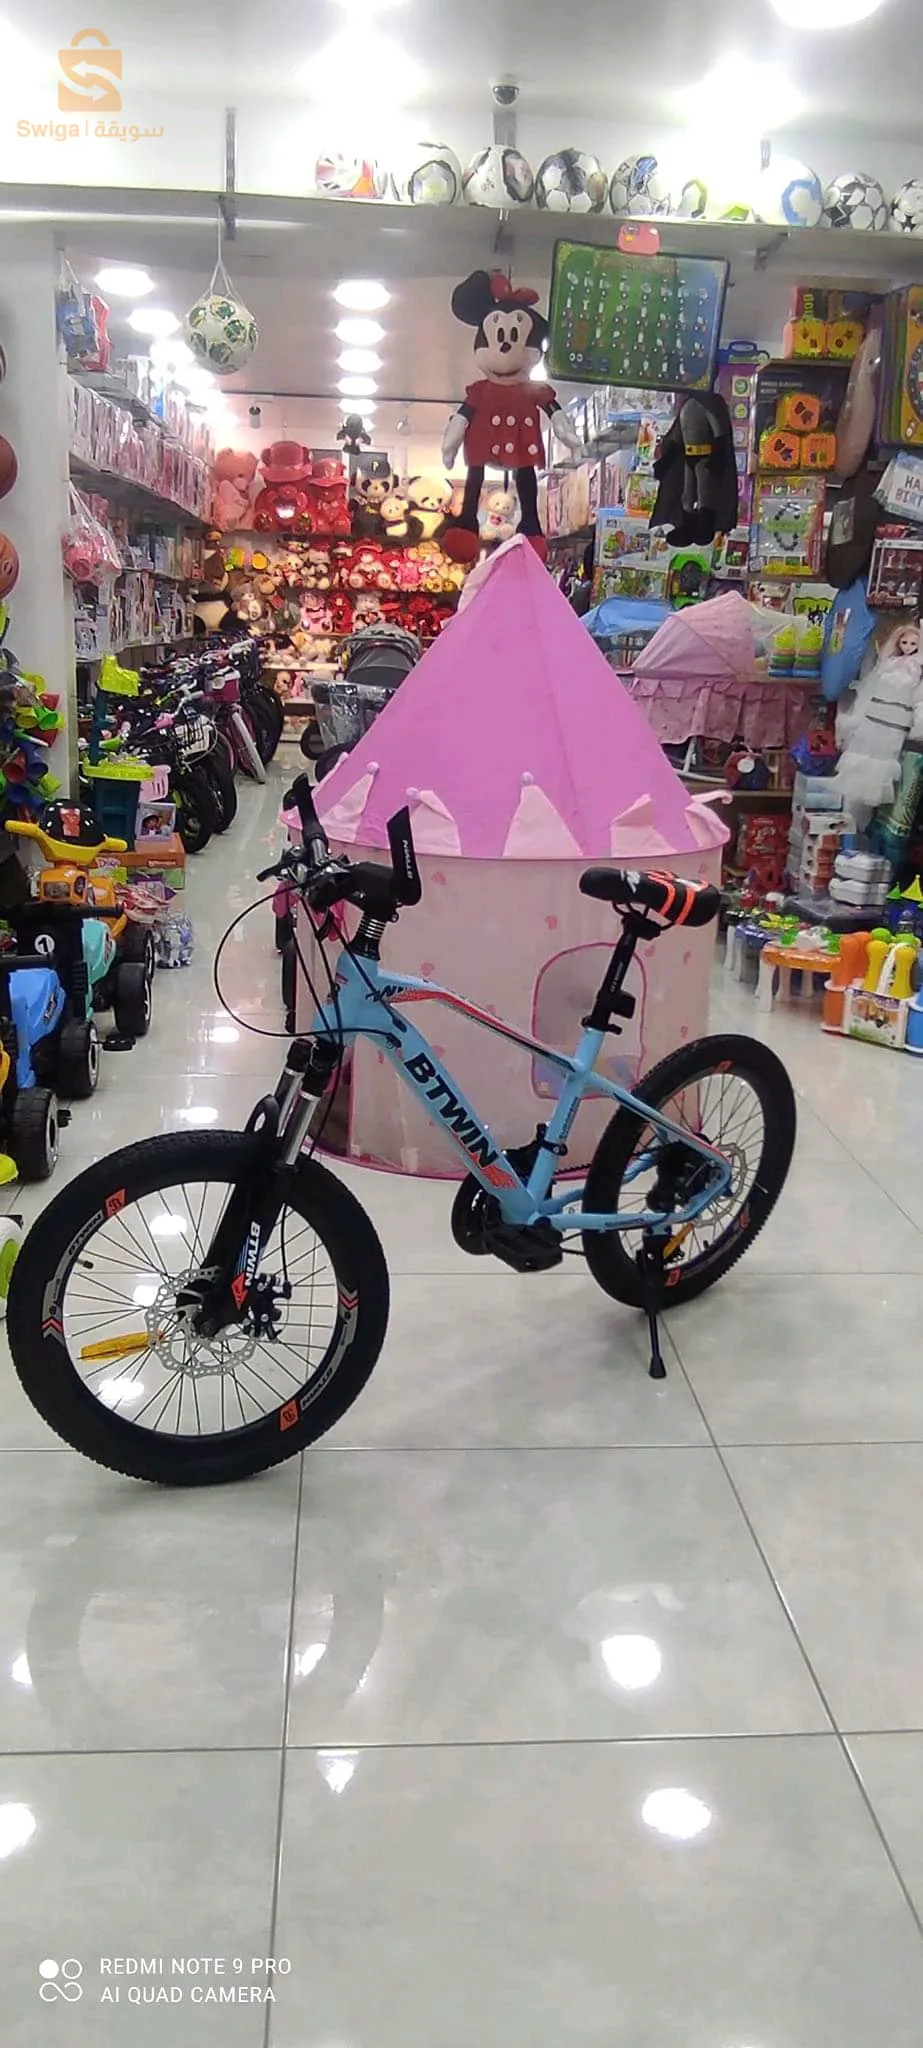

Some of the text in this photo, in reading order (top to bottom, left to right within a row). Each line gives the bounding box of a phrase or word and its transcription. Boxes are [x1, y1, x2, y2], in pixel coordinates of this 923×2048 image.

[38, 938, 49, 953] 1
[404, 1052, 499, 1168] BTWIN
[244, 1221, 261, 1287] BTWIN
